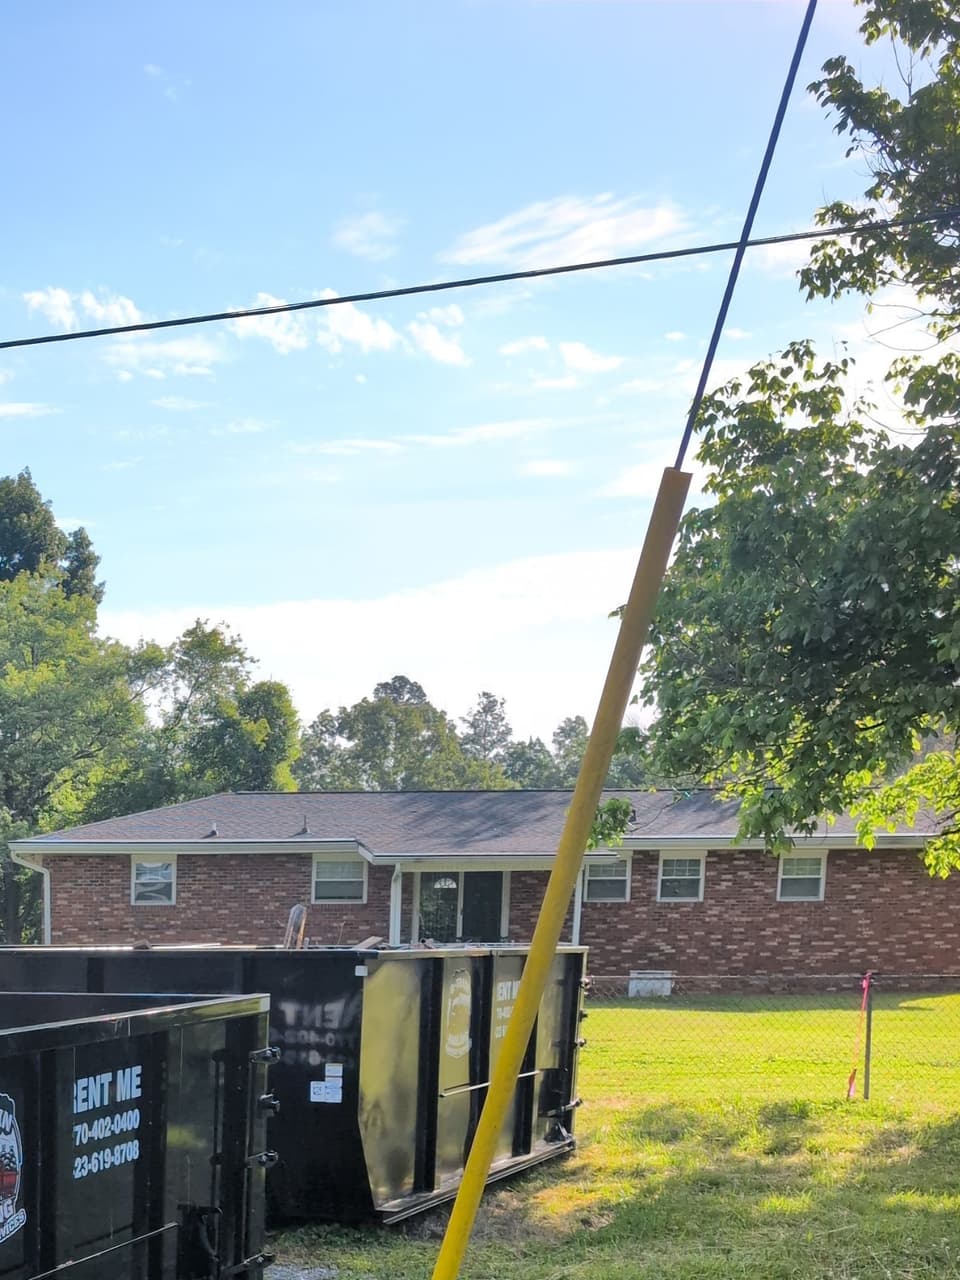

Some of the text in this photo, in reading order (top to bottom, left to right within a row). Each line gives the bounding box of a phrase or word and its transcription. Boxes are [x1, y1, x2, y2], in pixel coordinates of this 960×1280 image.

[73, 1065, 142, 1114] ENT ME
[72, 1139, 140, 1179] 23-619-8708
